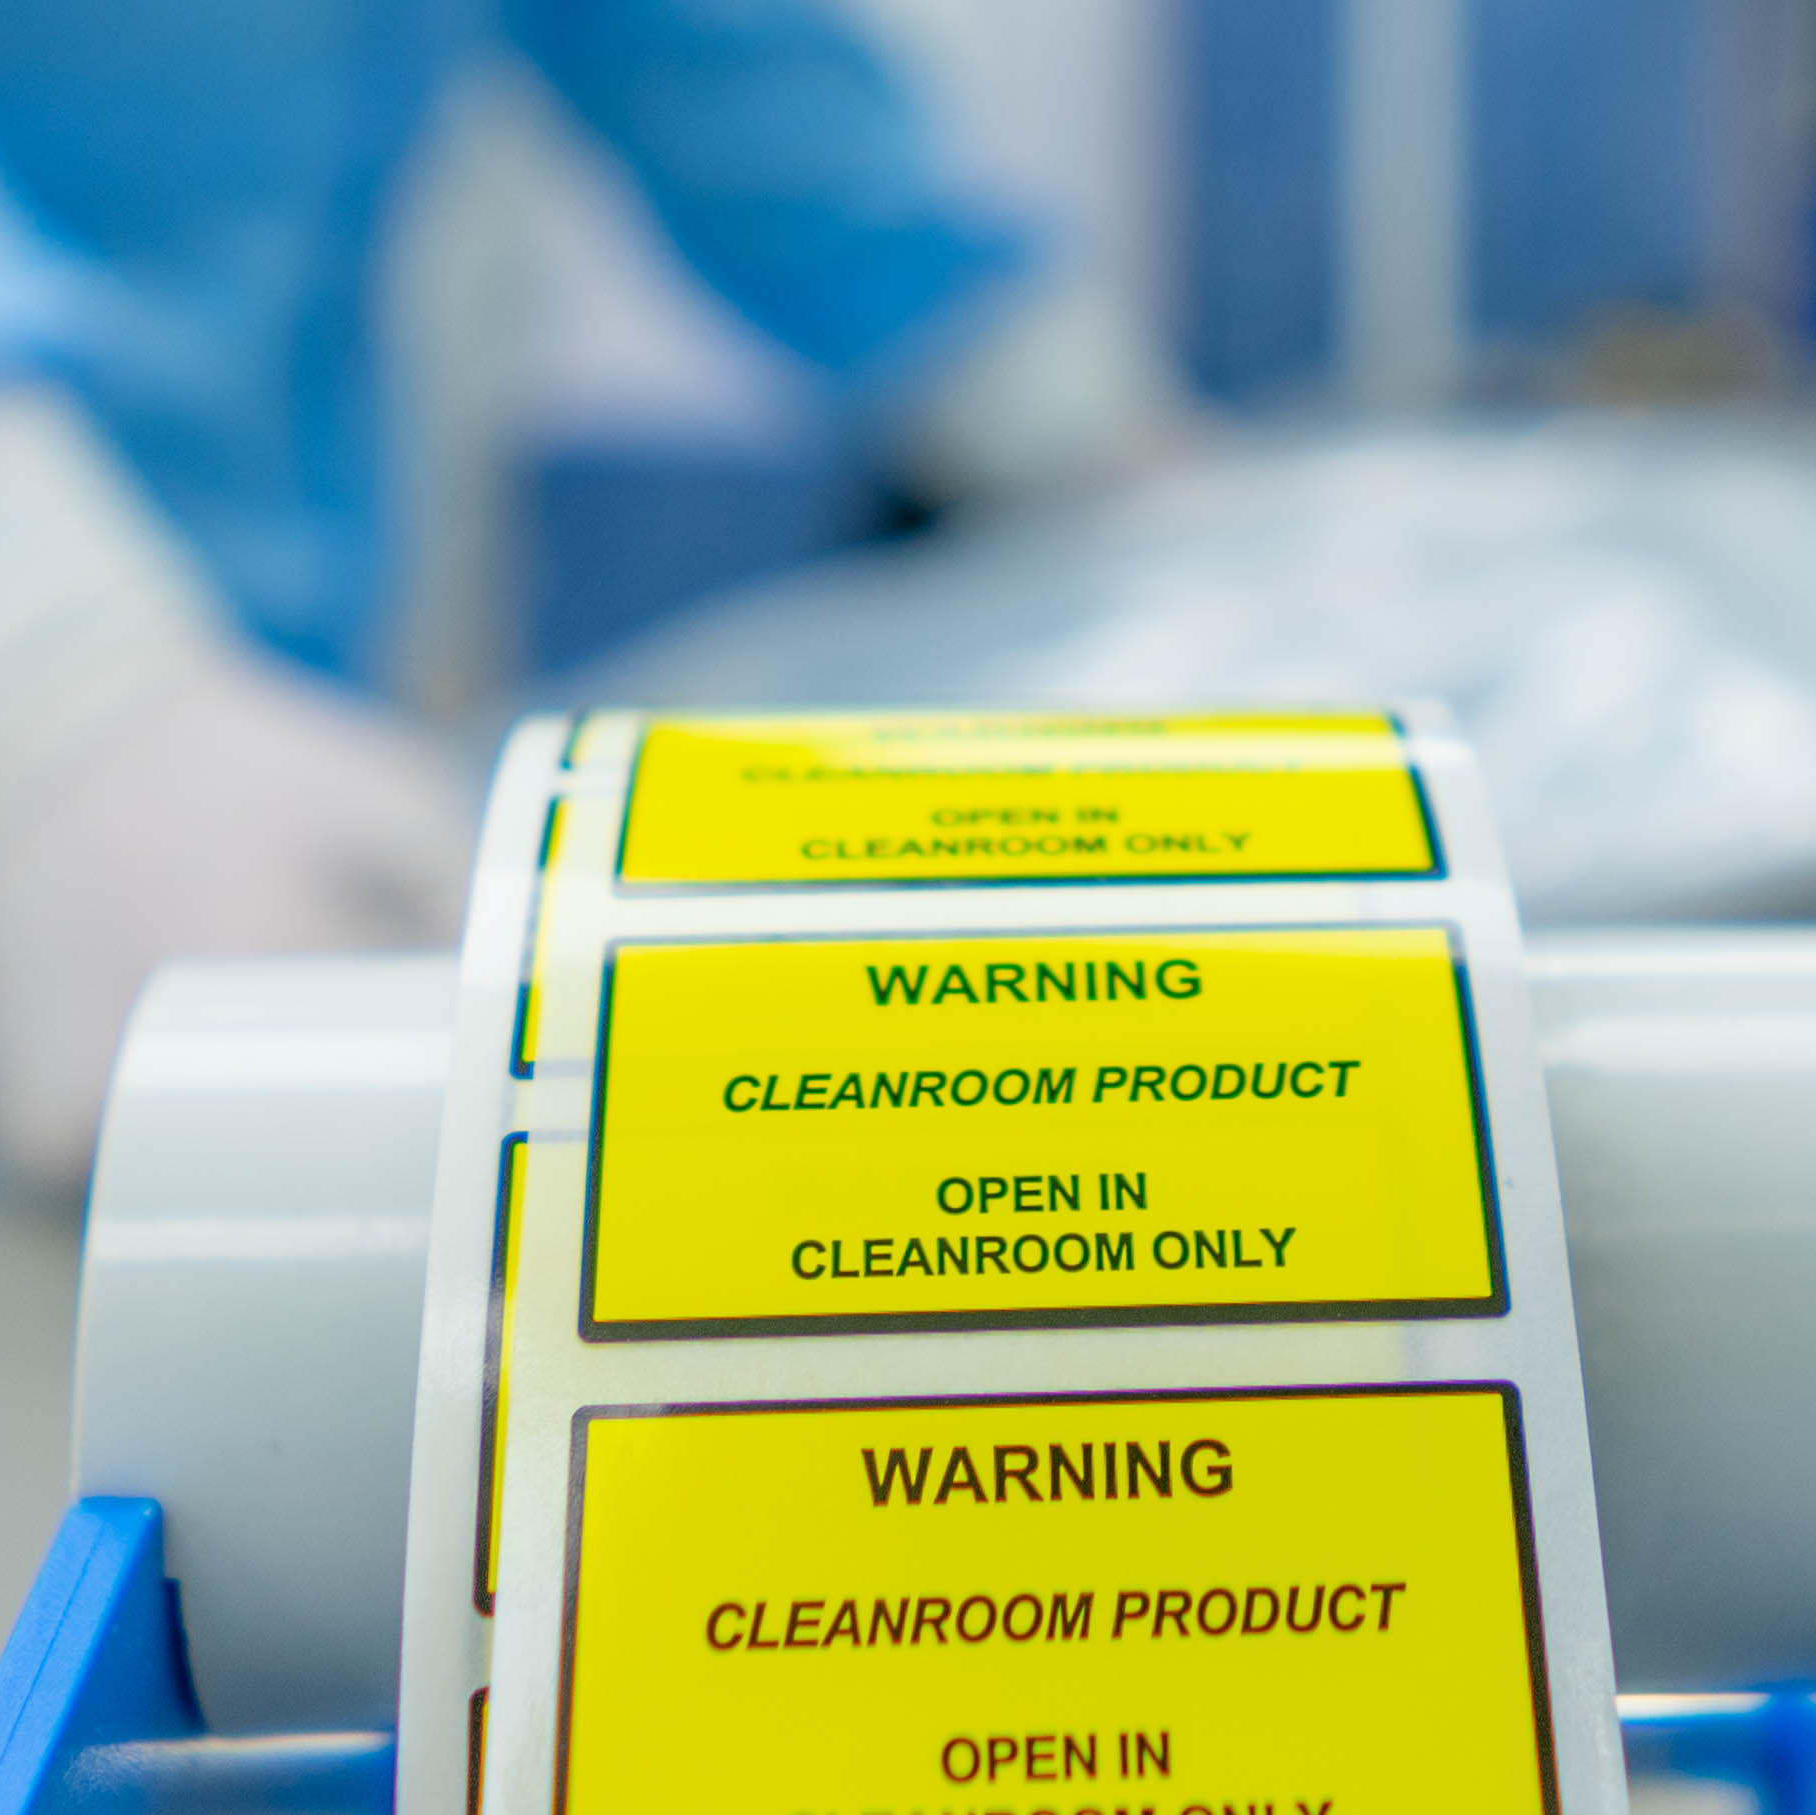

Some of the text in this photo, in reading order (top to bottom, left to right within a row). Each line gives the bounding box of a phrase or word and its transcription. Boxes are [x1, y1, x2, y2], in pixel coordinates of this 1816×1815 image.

[931, 806, 1120, 827] OPEN IN
[800, 832, 1251, 860] CLEANROOM ONLY
[866, 958, 1203, 1007] WARNING
[722, 1059, 1362, 1114] CLEANROOM PRODUCT
[935, 1171, 1148, 1216] OPEN IN
[791, 1226, 1297, 1281] CLEANROOM ONLY
[862, 1439, 1233, 1505] WARNING
[707, 1582, 1406, 1650] CLEANROOM PRODUCT
[940, 1731, 1171, 1784] OPEN IN
